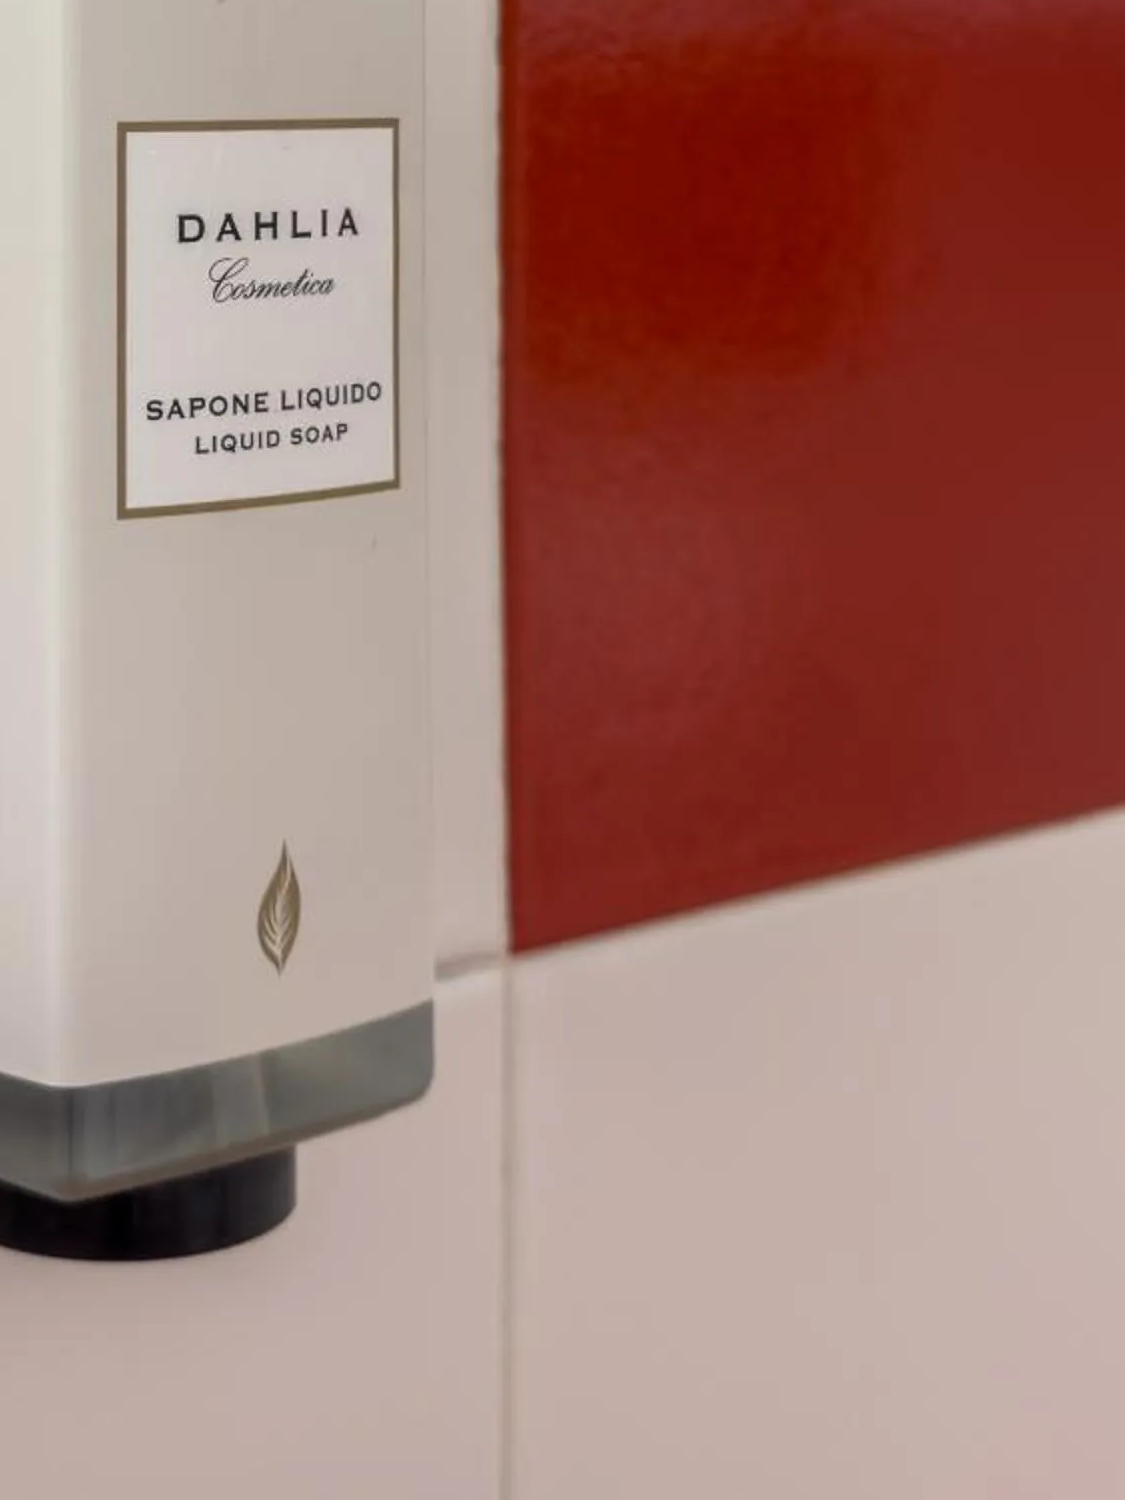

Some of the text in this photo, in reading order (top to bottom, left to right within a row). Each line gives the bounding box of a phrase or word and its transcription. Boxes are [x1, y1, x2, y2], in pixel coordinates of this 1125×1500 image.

[176, 207, 359, 244] DAHLIA
[208, 257, 335, 303] Cosmetica
[146, 381, 382, 421] SAPONE LIQUIDO
[194, 422, 349, 455] LIQUID SOAP
